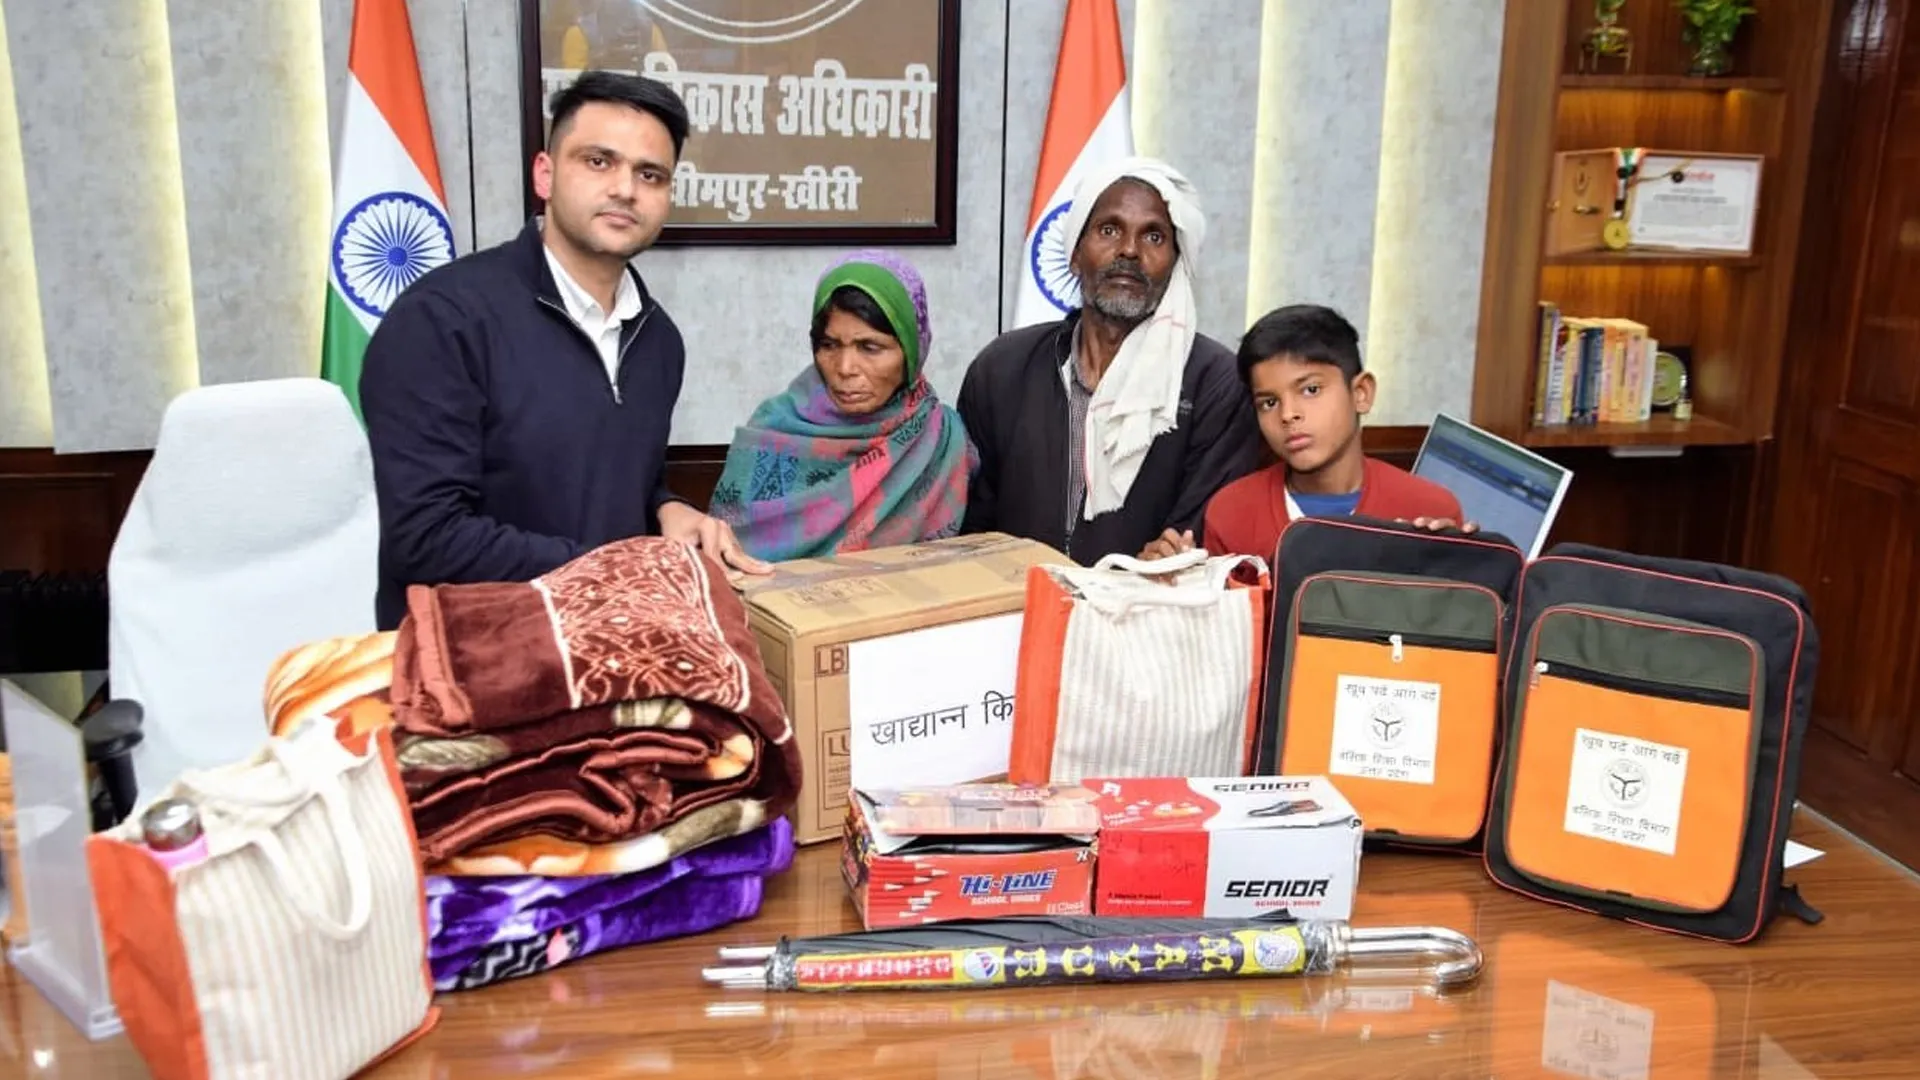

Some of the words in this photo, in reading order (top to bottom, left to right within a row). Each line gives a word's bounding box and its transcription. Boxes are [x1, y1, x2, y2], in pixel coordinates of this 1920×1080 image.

[777, 58, 937, 139] अधिकारी
[869, 703, 969, 745] खाद्यान्न
[982, 690, 1017, 724] कि
[1214, 781, 1310, 792] SENIOR
[1223, 878, 1330, 898] SENIOR
